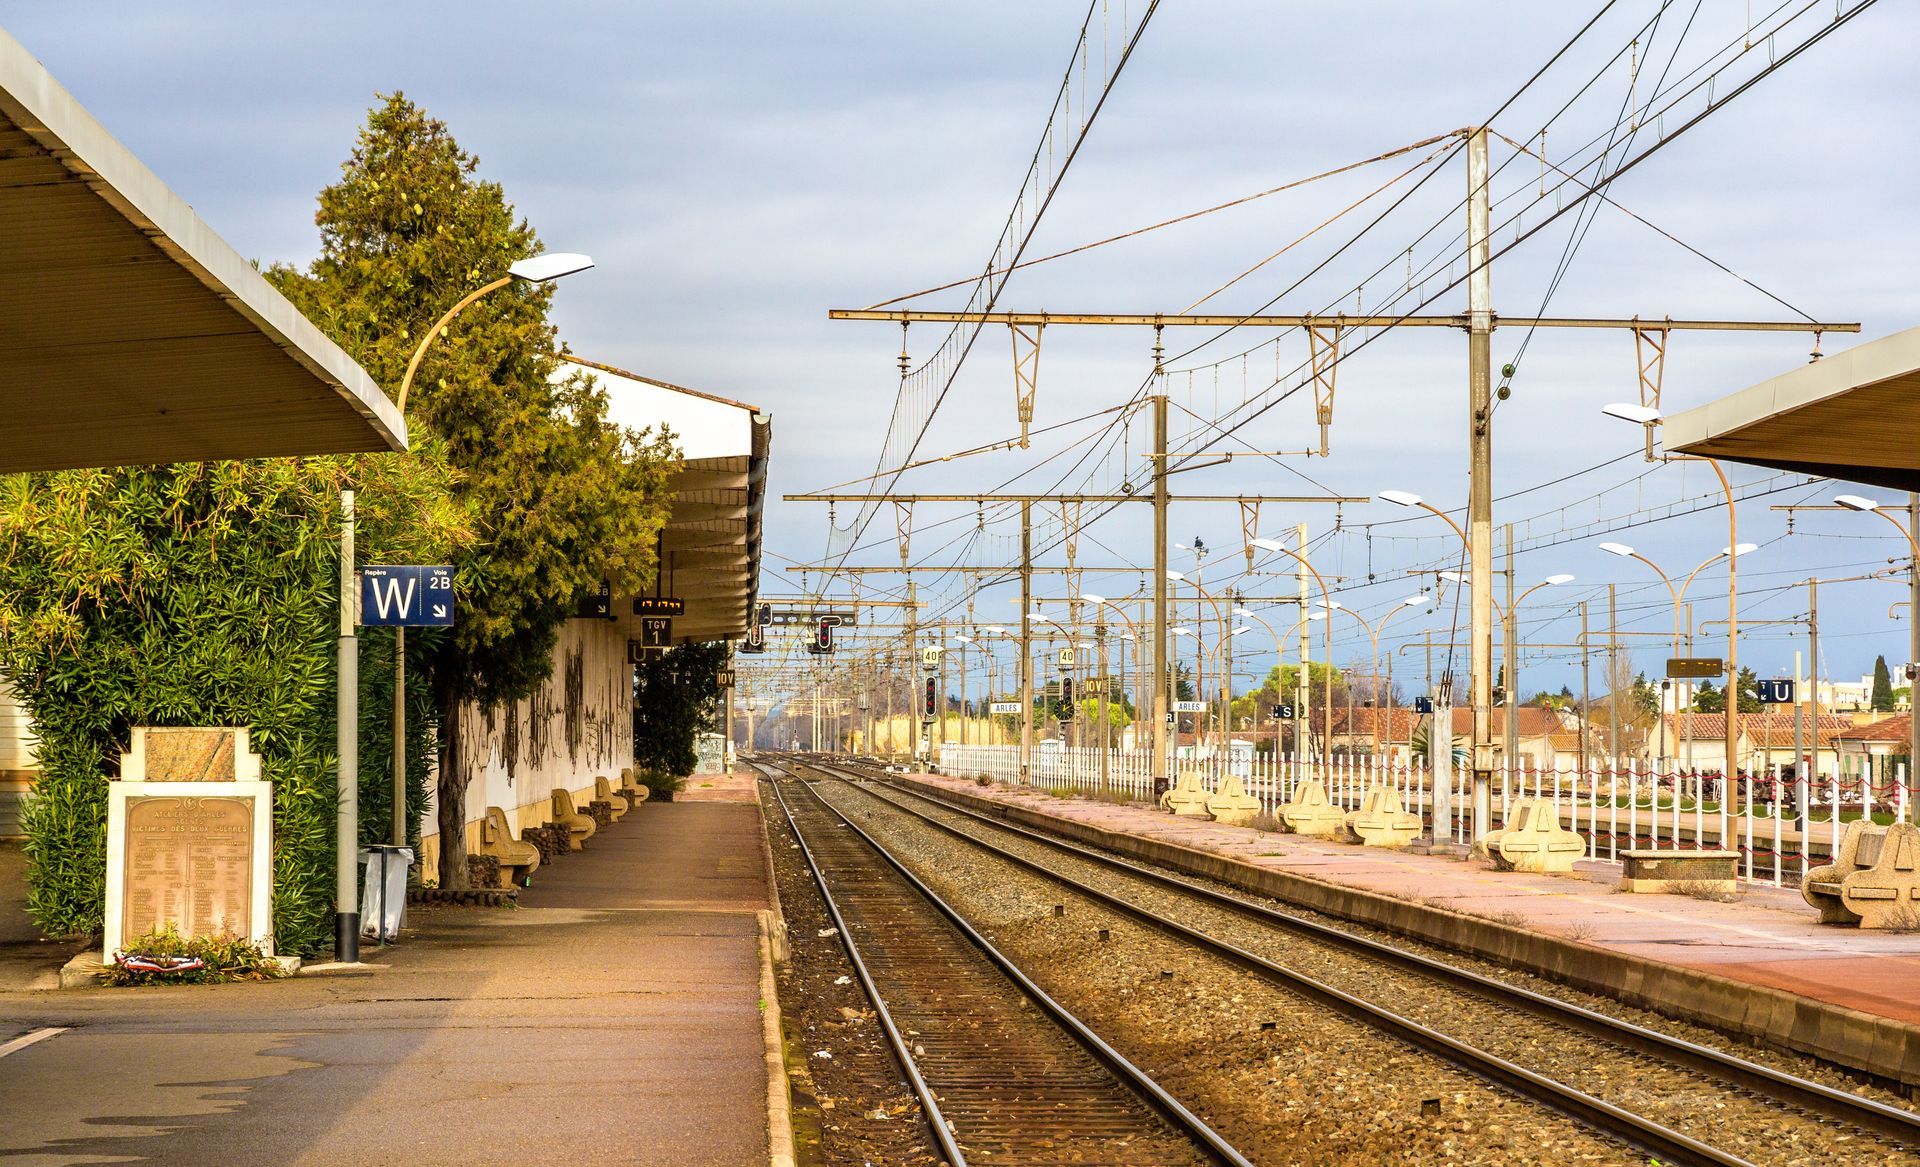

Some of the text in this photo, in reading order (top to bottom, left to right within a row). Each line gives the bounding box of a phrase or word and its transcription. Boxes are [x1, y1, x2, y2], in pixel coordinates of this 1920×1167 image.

[430, 577, 451, 589] 2B
[371, 578, 416, 619] W
[647, 620, 666, 629] TGV
[652, 631, 659, 644] 1
[925, 652, 937, 661] 40
[1062, 651, 1073, 661] 40
[1775, 684, 1789, 701] U
[995, 704, 1017, 712] ARLES
[1178, 702, 1201, 711] ARLES
[1283, 706, 1292, 718] S
[1166, 713, 1173, 722] R
